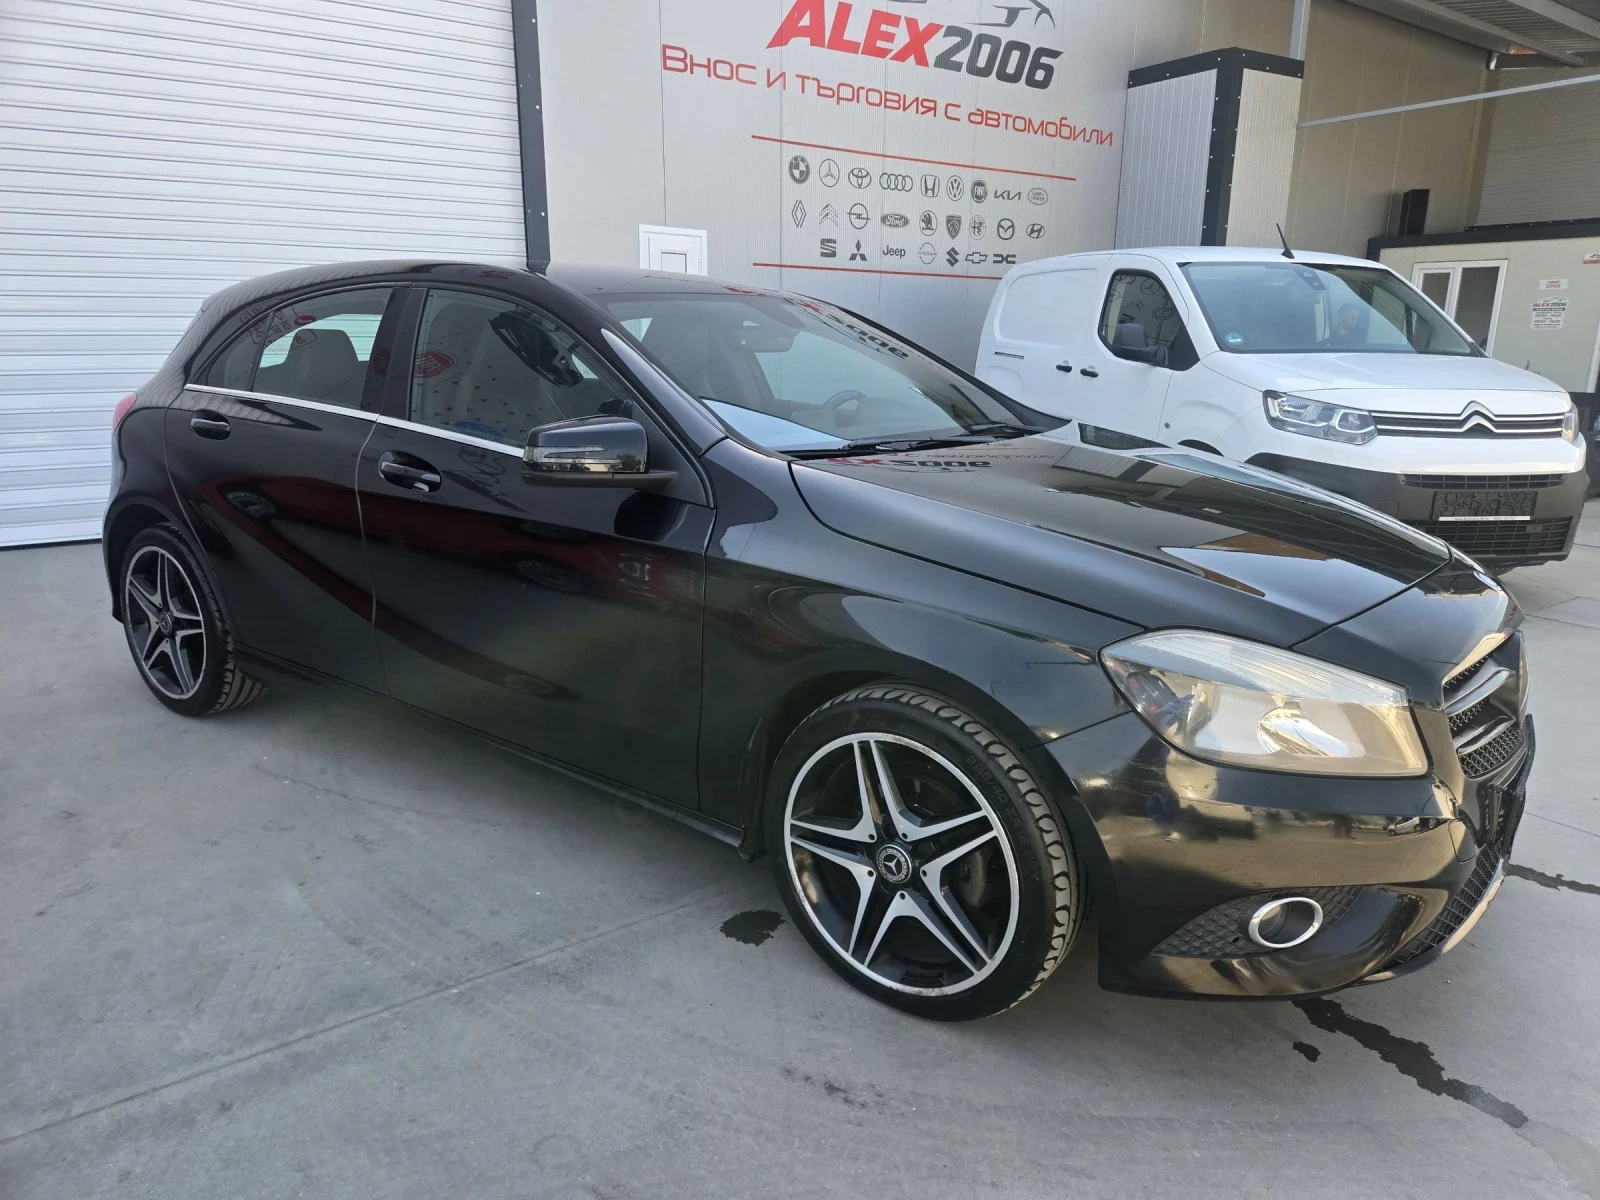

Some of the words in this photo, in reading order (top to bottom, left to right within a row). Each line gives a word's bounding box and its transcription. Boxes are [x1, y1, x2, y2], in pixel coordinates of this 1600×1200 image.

[766, 0, 1063, 90] ALEX2006
[662, 44, 757, 86] Внос
[766, 68, 787, 92] и
[796, 74, 937, 118] търговия
[944, 103, 961, 122] с
[967, 107, 1114, 148] автомобили
[882, 244, 906, 259] Jeep
